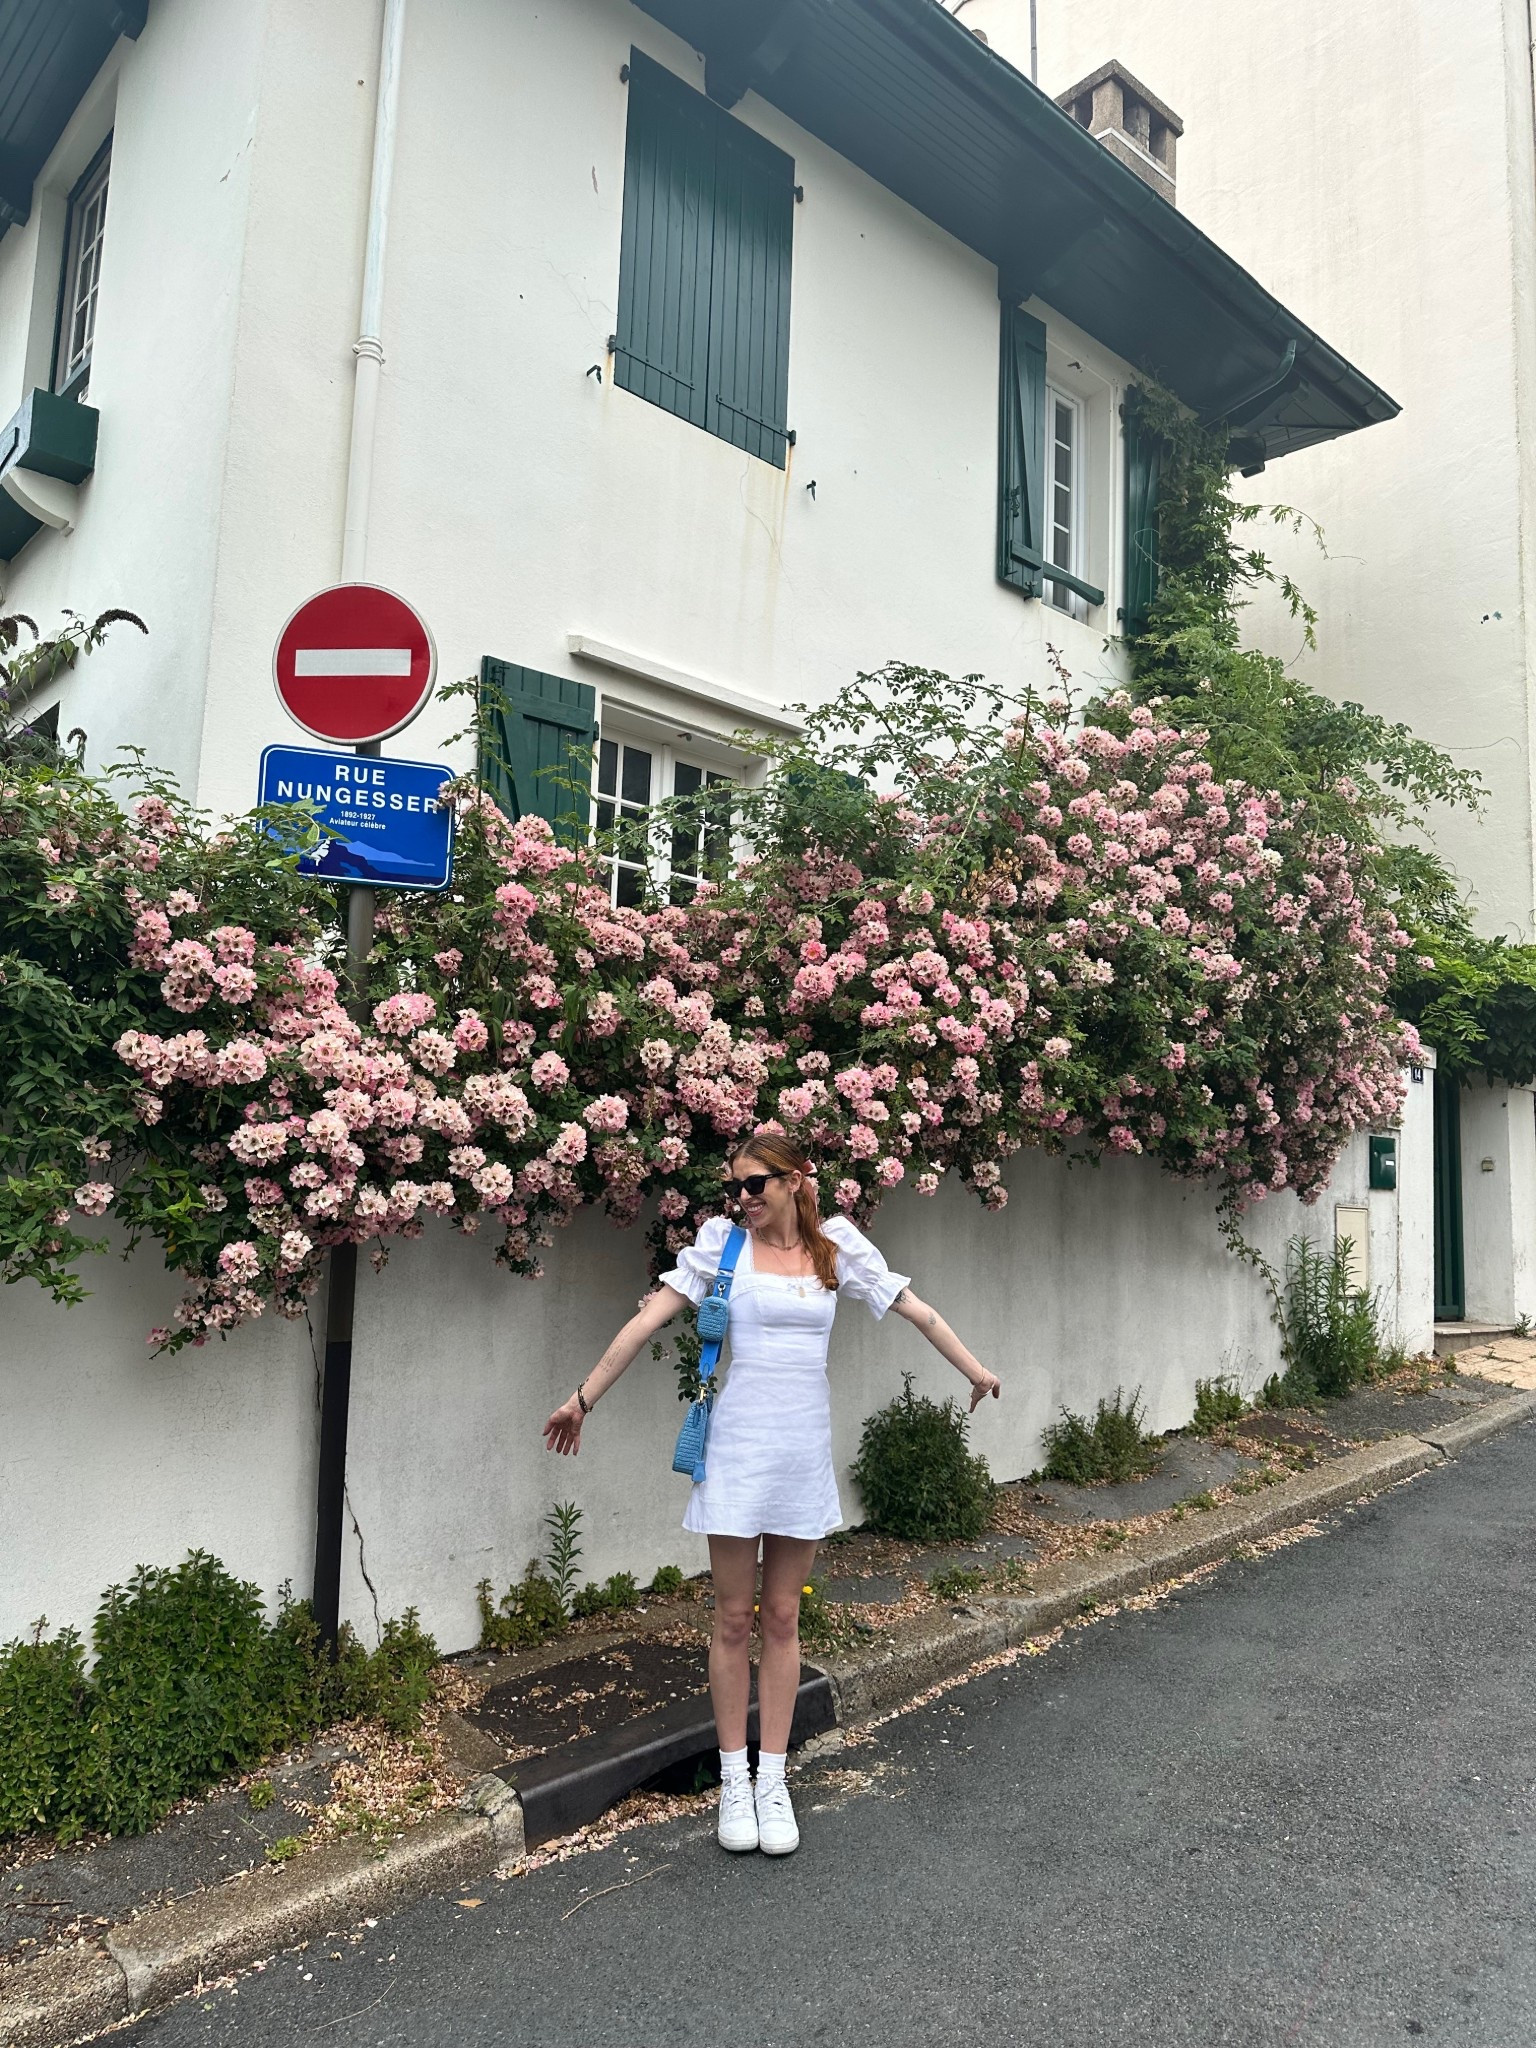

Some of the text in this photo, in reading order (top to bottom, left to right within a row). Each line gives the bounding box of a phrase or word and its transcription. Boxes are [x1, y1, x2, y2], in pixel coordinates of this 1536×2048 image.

[335, 765, 386, 786] RUE
[277, 780, 438, 815] NUNGESSER
[329, 817, 386, 830] Aviateur célèbre
[340, 810, 376, 820] 1892-1927
